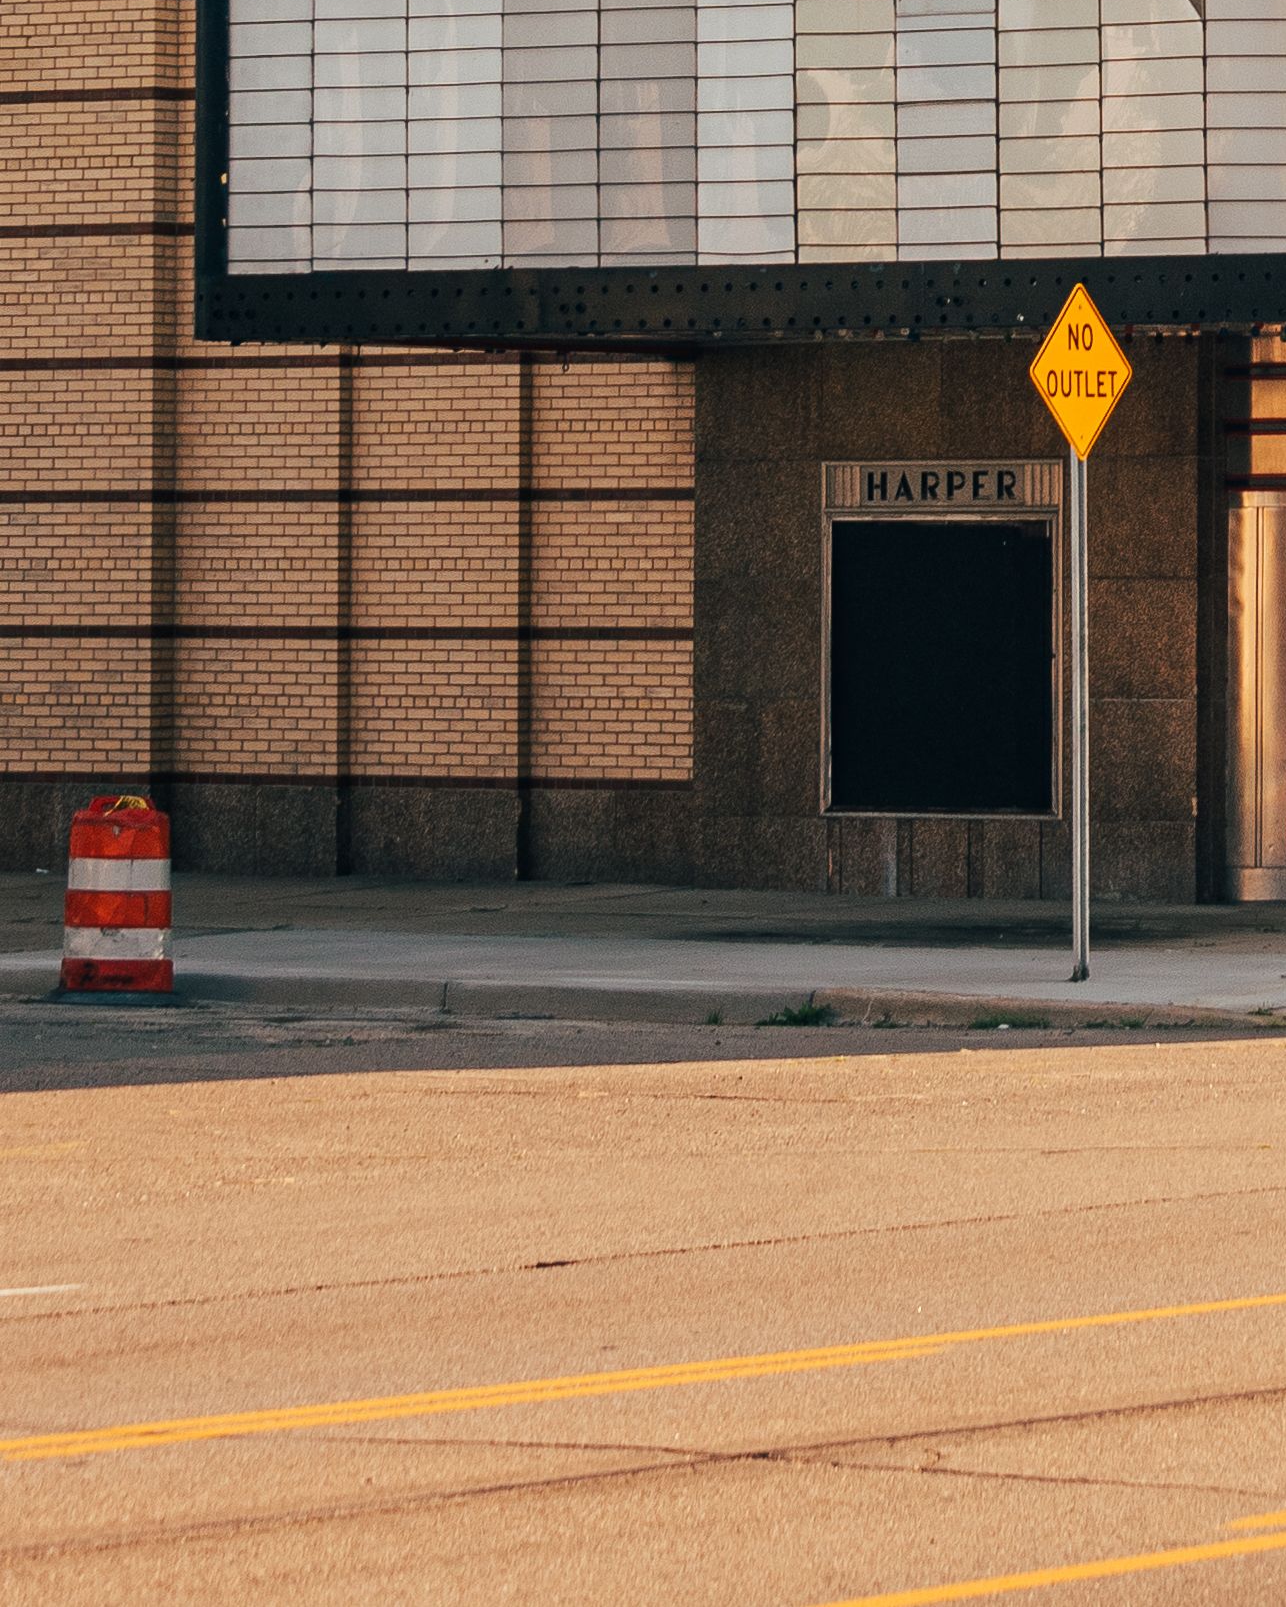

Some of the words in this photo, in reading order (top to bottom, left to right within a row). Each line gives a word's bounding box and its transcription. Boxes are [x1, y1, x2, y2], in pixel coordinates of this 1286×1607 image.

[1067, 323, 1094, 352] NO
[1046, 369, 1118, 398] OUTLET
[866, 469, 1017, 502] HARPER
